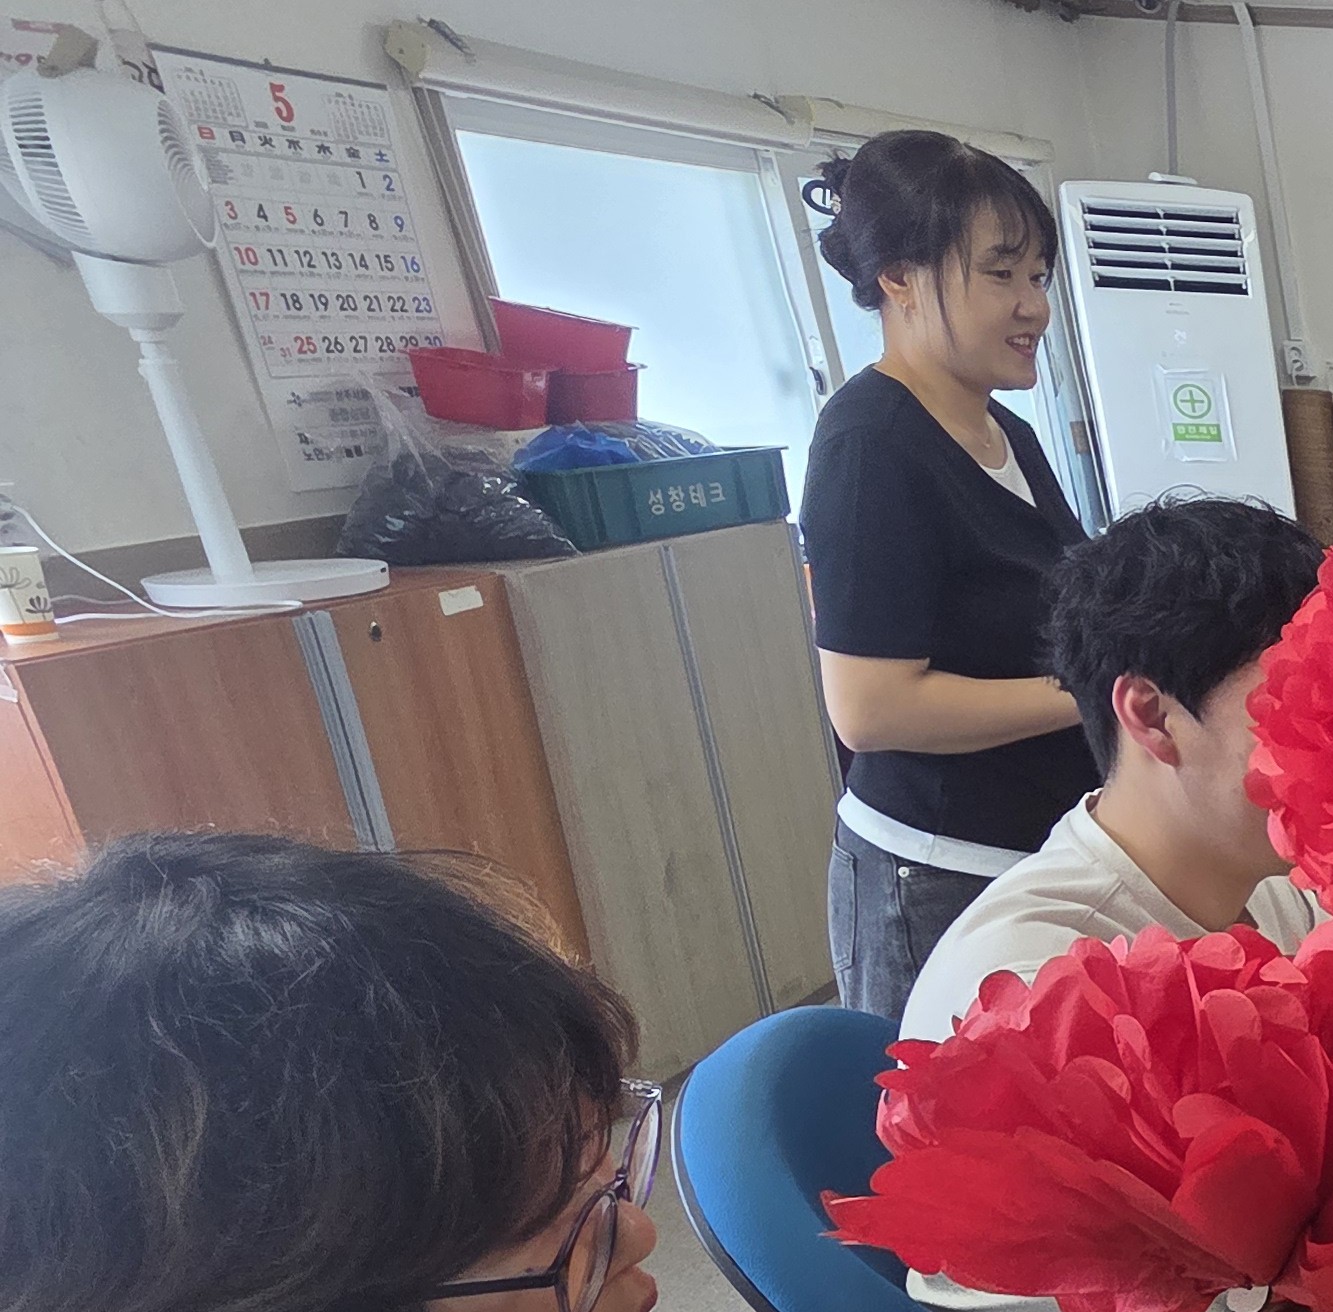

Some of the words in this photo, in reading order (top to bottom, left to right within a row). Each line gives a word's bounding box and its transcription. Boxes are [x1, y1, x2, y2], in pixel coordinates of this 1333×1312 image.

[269, 82, 295, 123] 5
[197, 126, 215, 140] 日
[258, 135, 276, 149] 火
[315, 143, 333, 156] 木
[375, 150, 390, 163] 土
[355, 171, 367, 189] 1
[382, 174, 395, 192] 2
[224, 200, 239, 220] 3
[256, 203, 268, 223] 4
[283, 206, 297, 225] 5
[313, 208, 324, 227] 6
[338, 210, 349, 228] 7
[367, 213, 380, 232] 8
[394, 215, 405, 233] 9
[233, 246, 259, 267] 10
[266, 248, 289, 268] 11
[294, 249, 317, 269] 12
[321, 251, 343, 270] 13
[348, 252, 369, 271] 14
[375, 253, 395, 272] 15
[400, 254, 421, 274] 16
[249, 292, 270, 311] 17
[280, 292, 303, 312] 18
[309, 293, 329, 312] 19
[335, 294, 358, 312] 20
[363, 294, 383, 313] 21
[387, 296, 410, 313] 22
[412, 296, 433, 314] 23
[294, 335, 317, 354] 25
[321, 335, 345, 354] 26
[349, 336, 368, 354] 27
[375, 336, 396, 353] 28
[648, 481, 726, 516] 성창테크
